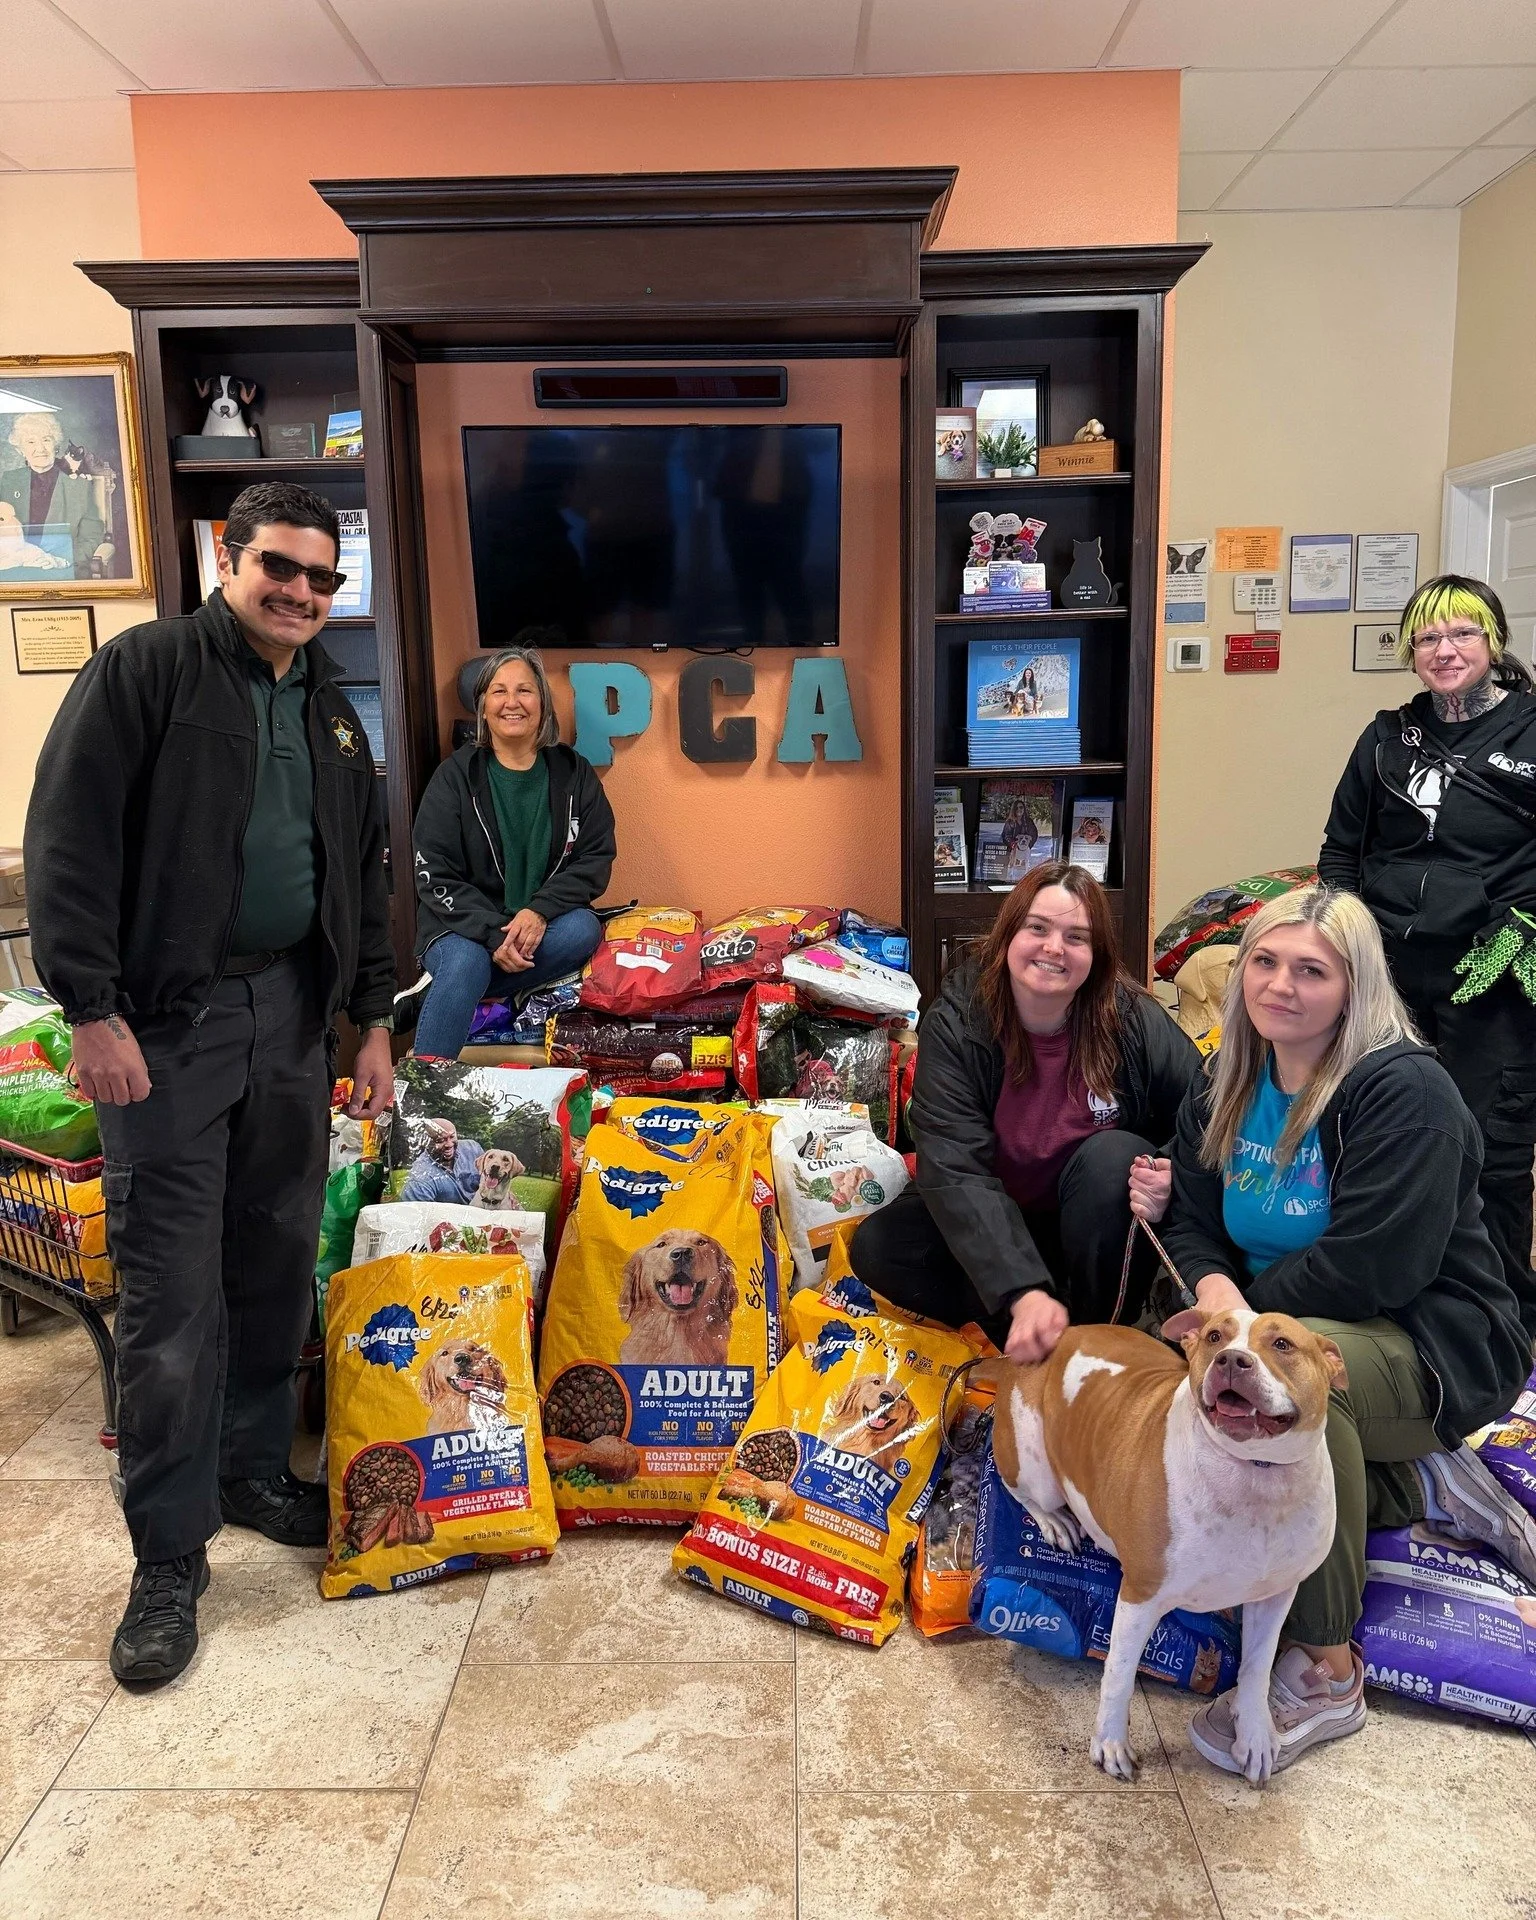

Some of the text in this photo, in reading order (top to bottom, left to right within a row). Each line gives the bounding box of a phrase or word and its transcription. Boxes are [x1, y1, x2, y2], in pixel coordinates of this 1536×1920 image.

[1056, 455, 1095, 467] Winnie
[992, 644, 1006, 652] PETS
[1014, 643, 1033, 651] THEIR
[1034, 643, 1057, 651] PEOPLE
[694, 1054, 727, 1065] SIZE!
[619, 1114, 716, 1131] Pedigree
[584, 1156, 685, 1195] Pedigree
[1224, 1164, 1325, 1215] veryone
[345, 1325, 432, 1354] Pedigree
[803, 1336, 867, 1360] Pedigree
[640, 1370, 749, 1397] ADULT
[664, 1401, 702, 1410] Complete
[712, 1401, 748, 1409] Balanced
[704, 1410, 726, 1418] Adult
[728, 1410, 747, 1419] Dogs
[662, 1421, 679, 1431] NO
[697, 1421, 714, 1431] NO
[732, 1421, 747, 1431] NO
[431, 1429, 524, 1461] ADULT
[432, 1461, 451, 1470] 100%
[452, 1456, 482, 1466] Complete
[456, 1464, 472, 1472] Food
[505, 1458, 520, 1466] Dogs
[645, 1452, 692, 1462] ROASTED
[481, 1470, 495, 1479] NO
[508, 1466, 521, 1475] NO
[647, 1463, 705, 1472] VEGETABLE
[813, 1464, 830, 1474] 100%
[831, 1470, 860, 1487] Complete
[860, 1480, 866, 1489] &
[818, 1447, 896, 1498] ADULT
[453, 1473, 466, 1483] NO
[832, 1478, 848, 1489] Food
[848, 1485, 858, 1493] for
[453, 1490, 516, 1507] GRILLED STEAK
[627, 1490, 693, 1501] NET WT 50 LB (22.7 kg)
[443, 1497, 525, 1517] VEGETABLE FLAVOR
[804, 1503, 841, 1524] ROASTED
[841, 1516, 876, 1539] CHICKEN
[974, 1484, 993, 1561] Essentials
[804, 1512, 880, 1551] VEGETABLE FLAVOR
[706, 1526, 761, 1562] BONUS
[760, 1549, 801, 1578] SIZE
[1409, 1542, 1500, 1579] IAMS
[1036, 1553, 1065, 1565] Healthy
[1066, 1558, 1082, 1568] Skin
[1090, 1565, 1107, 1574] Coat
[1081, 1555, 1110, 1568] Support
[395, 1563, 448, 1587] ADULT
[805, 1574, 833, 1591] MORE
[1410, 1557, 1522, 1597] PROACTIVE HEALT
[1411, 1567, 1483, 1589] HEALTHY KITTEN
[725, 1579, 772, 1609] ADULT
[834, 1576, 881, 1612] FREE
[989, 1605, 1061, 1635] 9Lives
[1478, 1612, 1520, 1632] 0% Fillers
[1365, 1625, 1437, 1650] NET WT 16 LB (7.26 kg)
[1479, 1622, 1521, 1639] 100% Complete
[1491, 1630, 1516, 1643] Balanced
[1480, 1633, 1522, 1650] Kitten Nutrition
[1446, 1686, 1516, 1711] HEALTHY KITTEN
